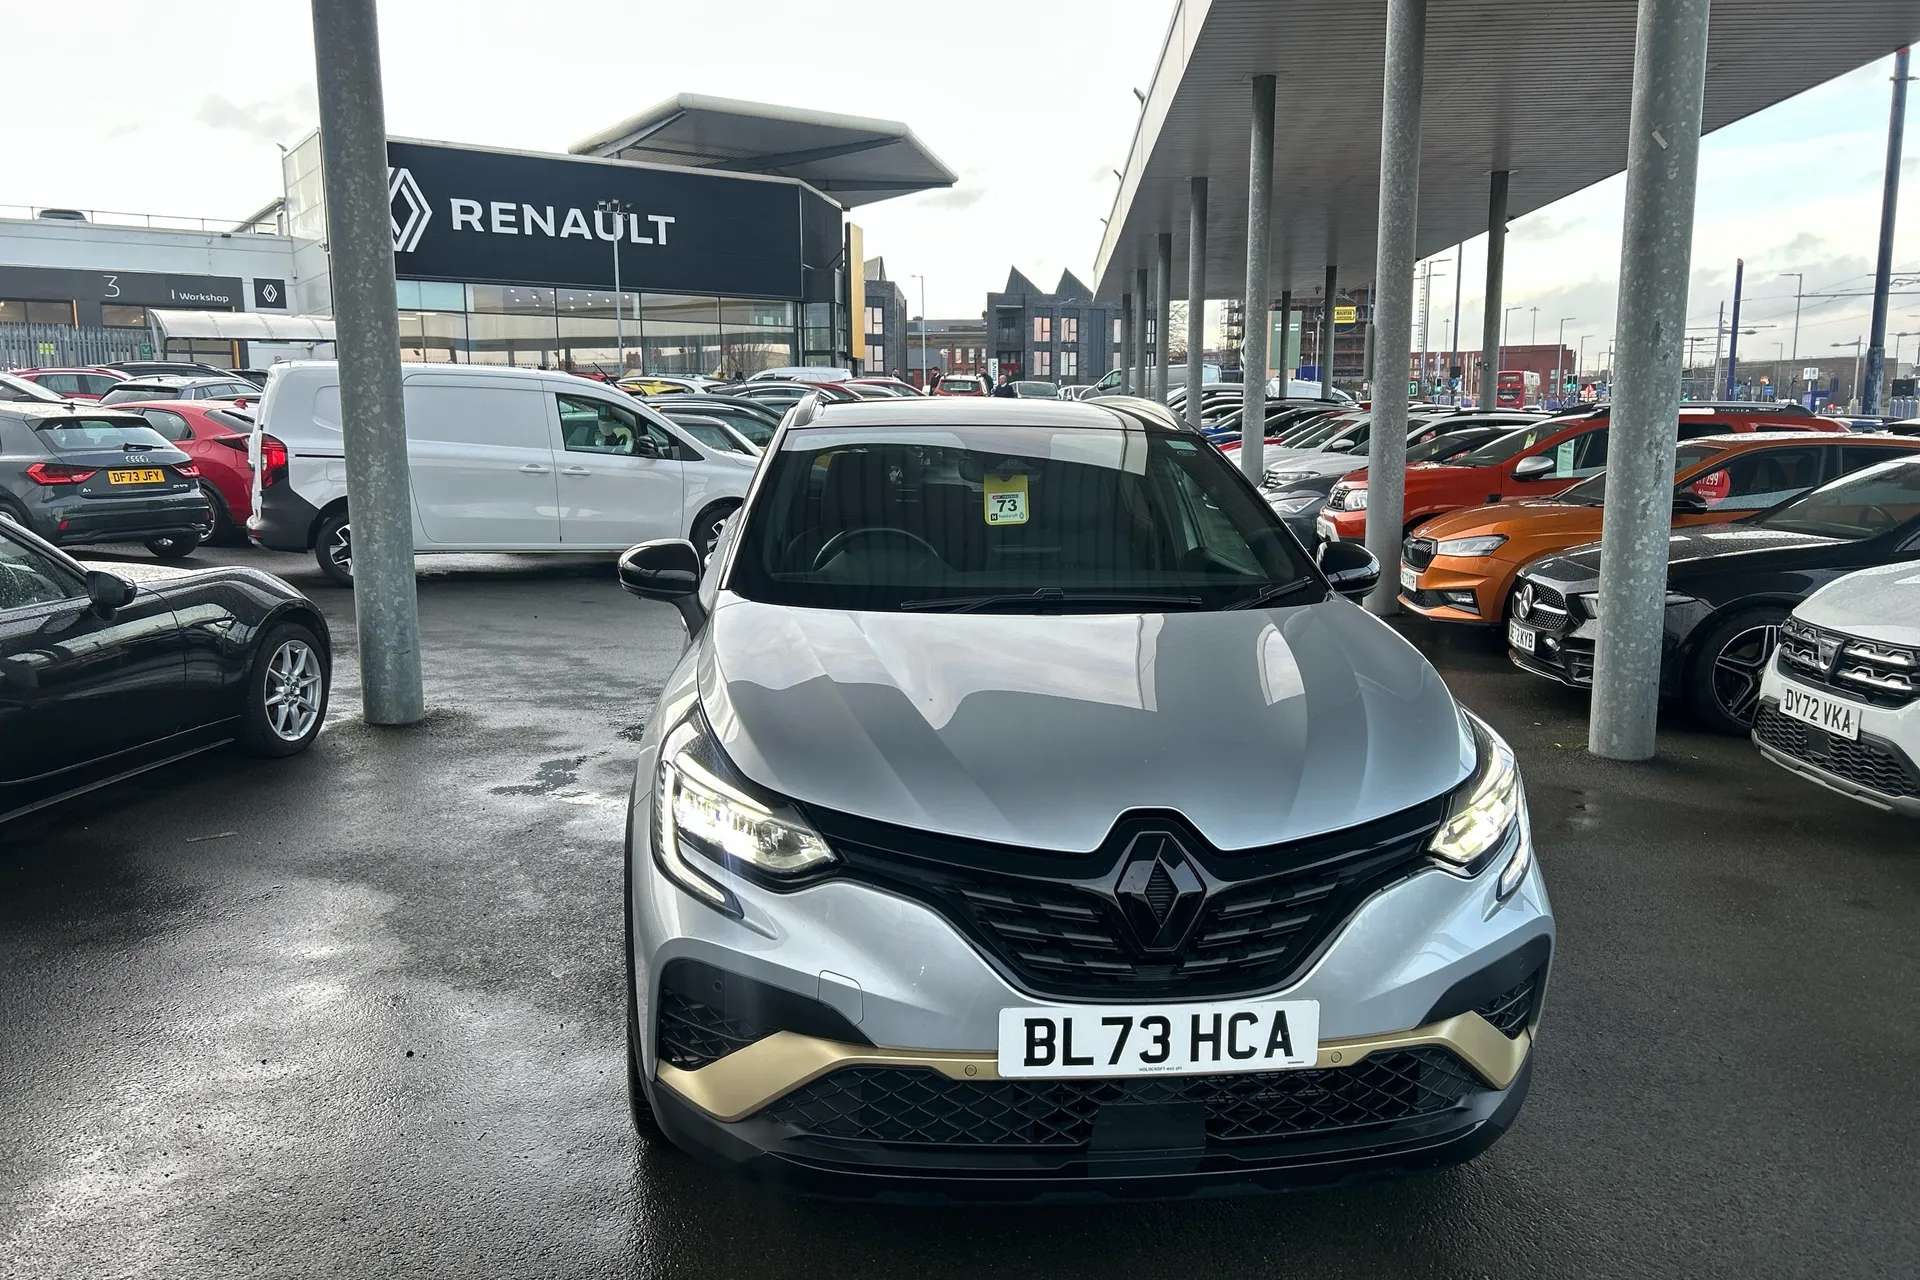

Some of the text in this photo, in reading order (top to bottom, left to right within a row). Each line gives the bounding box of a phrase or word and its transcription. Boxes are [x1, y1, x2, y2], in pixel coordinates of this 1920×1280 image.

[450, 198, 676, 246] RENAULT
[103, 275, 121, 298] 3
[178, 292, 229, 304] Workshop
[112, 470, 160, 483] DF73 JFY
[996, 499, 1018, 513] 73
[1785, 688, 1851, 734] DY72 VKA
[1023, 1010, 1294, 1067] BL73 HCA
